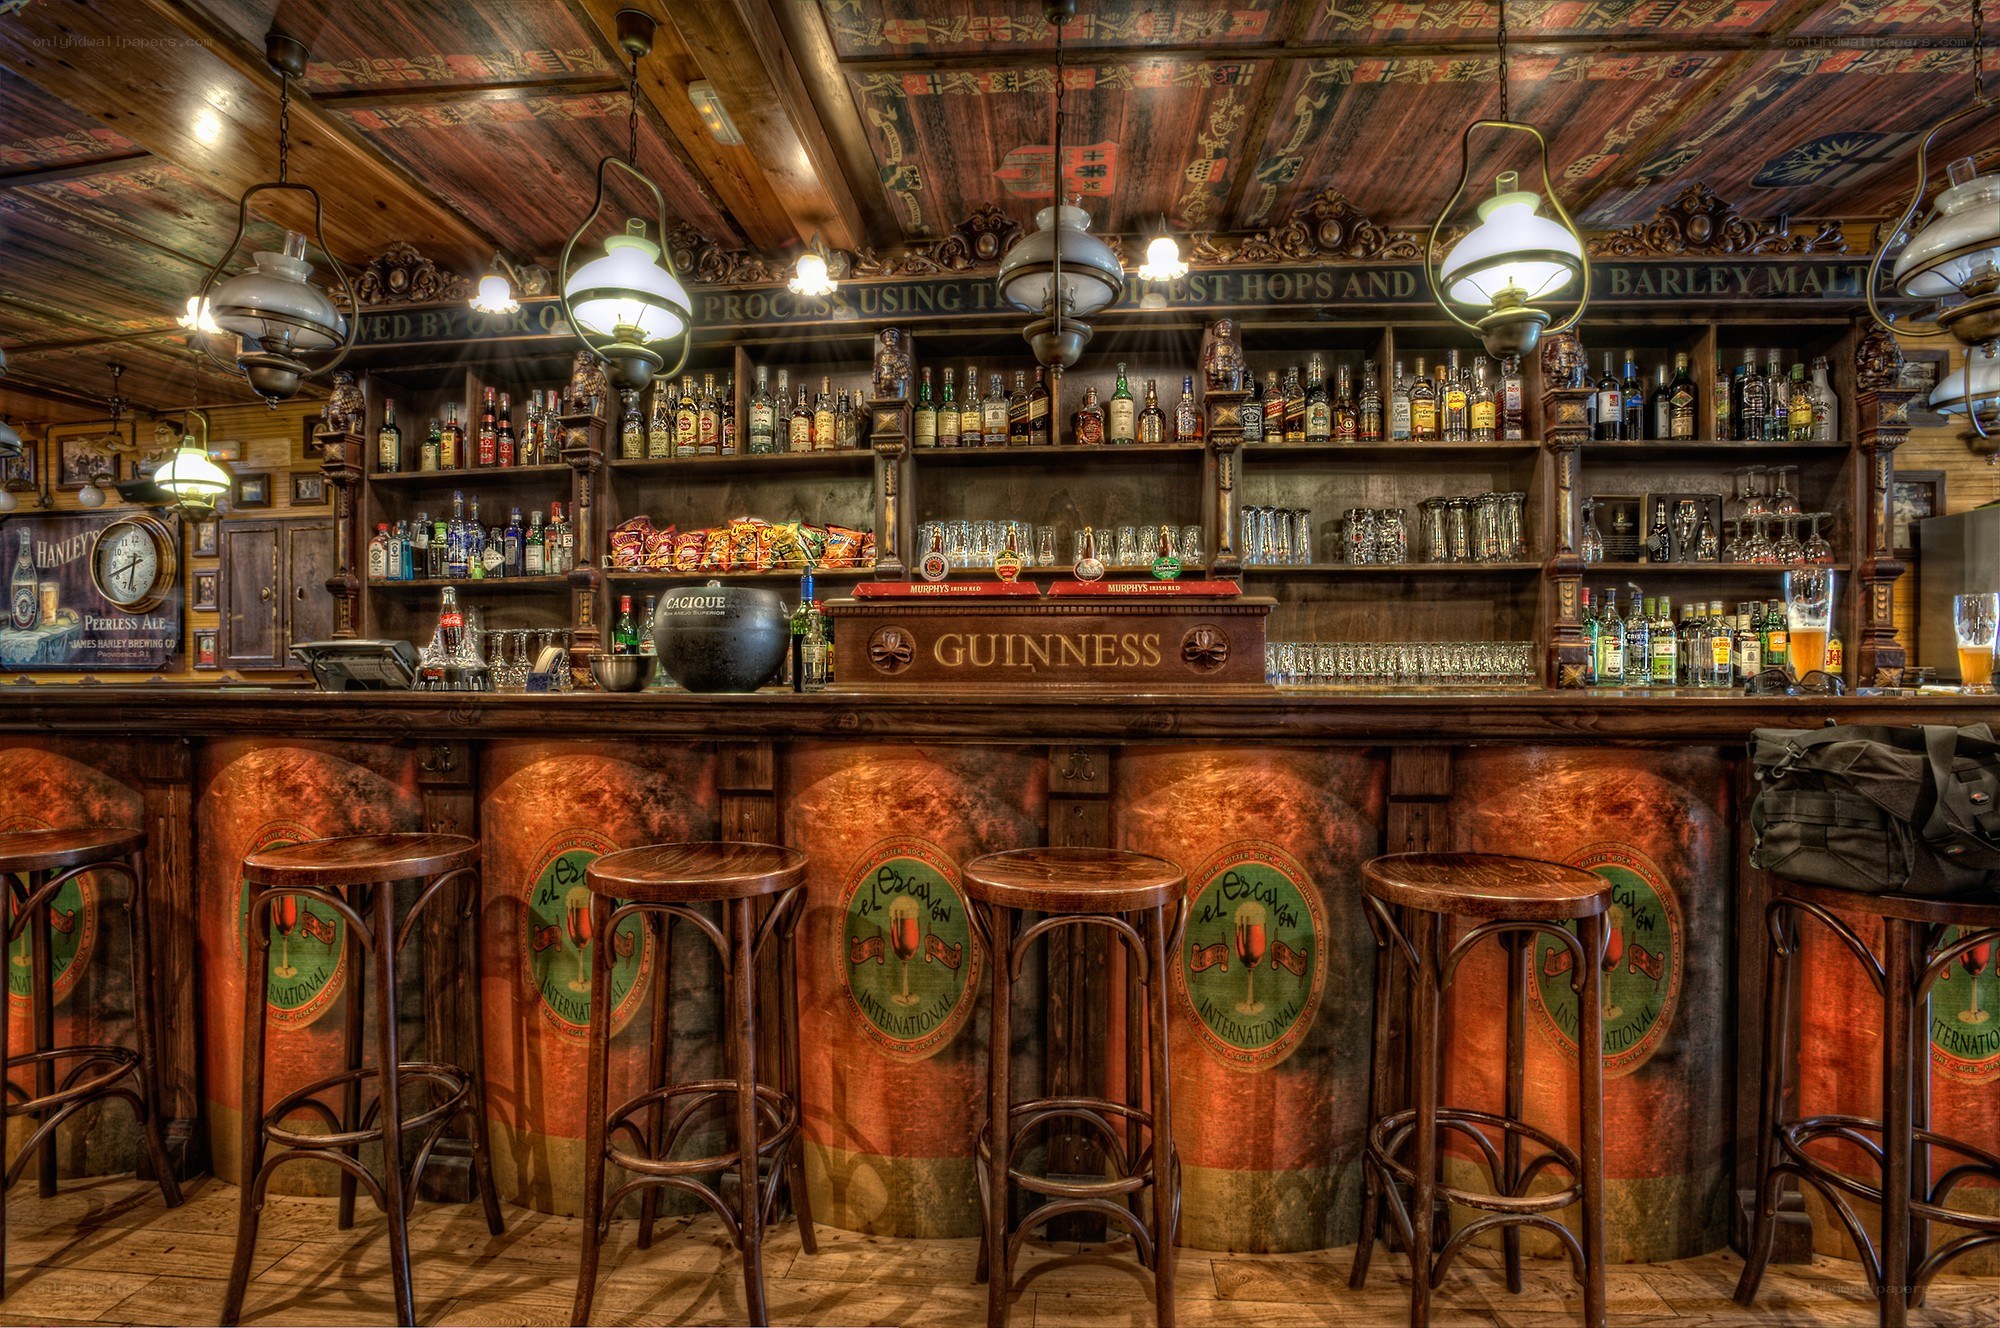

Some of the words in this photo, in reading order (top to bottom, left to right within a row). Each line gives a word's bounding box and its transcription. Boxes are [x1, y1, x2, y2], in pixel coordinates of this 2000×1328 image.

[1240, 271, 1334, 302] HOPS
[1342, 270, 1416, 299] AND
[1610, 266, 1754, 295] BARLEY
[1767, 265, 1868, 295] MALT
[704, 288, 848, 321] PROCESS
[859, 282, 961, 314] USING
[421, 311, 458, 338] BY
[467, 308, 530, 335] OUR
[36, 530, 100, 568] HANLEY'S
[910, 585, 949, 593] MURPHY'S
[1108, 584, 1148, 593] MURPHY'S
[666, 597, 726, 610] CACIQUE
[84, 615, 138, 631] PEERLESS
[142, 614, 166, 630] ALE
[71, 639, 97, 649] JAMES
[97, 639, 126, 648] HANLEY
[128, 640, 163, 648] BREWING
[933, 633, 1161, 667] GUINNESS
[556, 840, 578, 850] BITTER
[581, 840, 599, 849] BOCK
[880, 848, 902, 859] BITTER
[907, 848, 926, 857] BOCK
[930, 856, 948, 873] DARK
[1224, 852, 1250, 865] BITTER
[1254, 853, 1274, 863] BOCK
[1278, 862, 1296, 878] DARK
[1581, 854, 1607, 867] BITTER
[1612, 855, 1631, 865] BOCK
[1636, 862, 1653, 880] DARK
[857, 884, 882, 917] el
[1199, 889, 1227, 924] el
[269, 966, 329, 1005] RNATIONAL
[541, 975, 627, 1021] INTERNATAL
[859, 988, 954, 1036] INTERNATIONAL
[1199, 997, 1298, 1045] INTERNATIONAL
[1555, 1002, 1656, 1050] INTATIONAL
[1231, 1053, 1255, 1062] LAGER
[1258, 1038, 1291, 1062] PILSENER
[1557, 1037, 1579, 1058] EXPOR
[1617, 1044, 1648, 1066] PILSENER
[1954, 1063, 1979, 1073] LAGER
